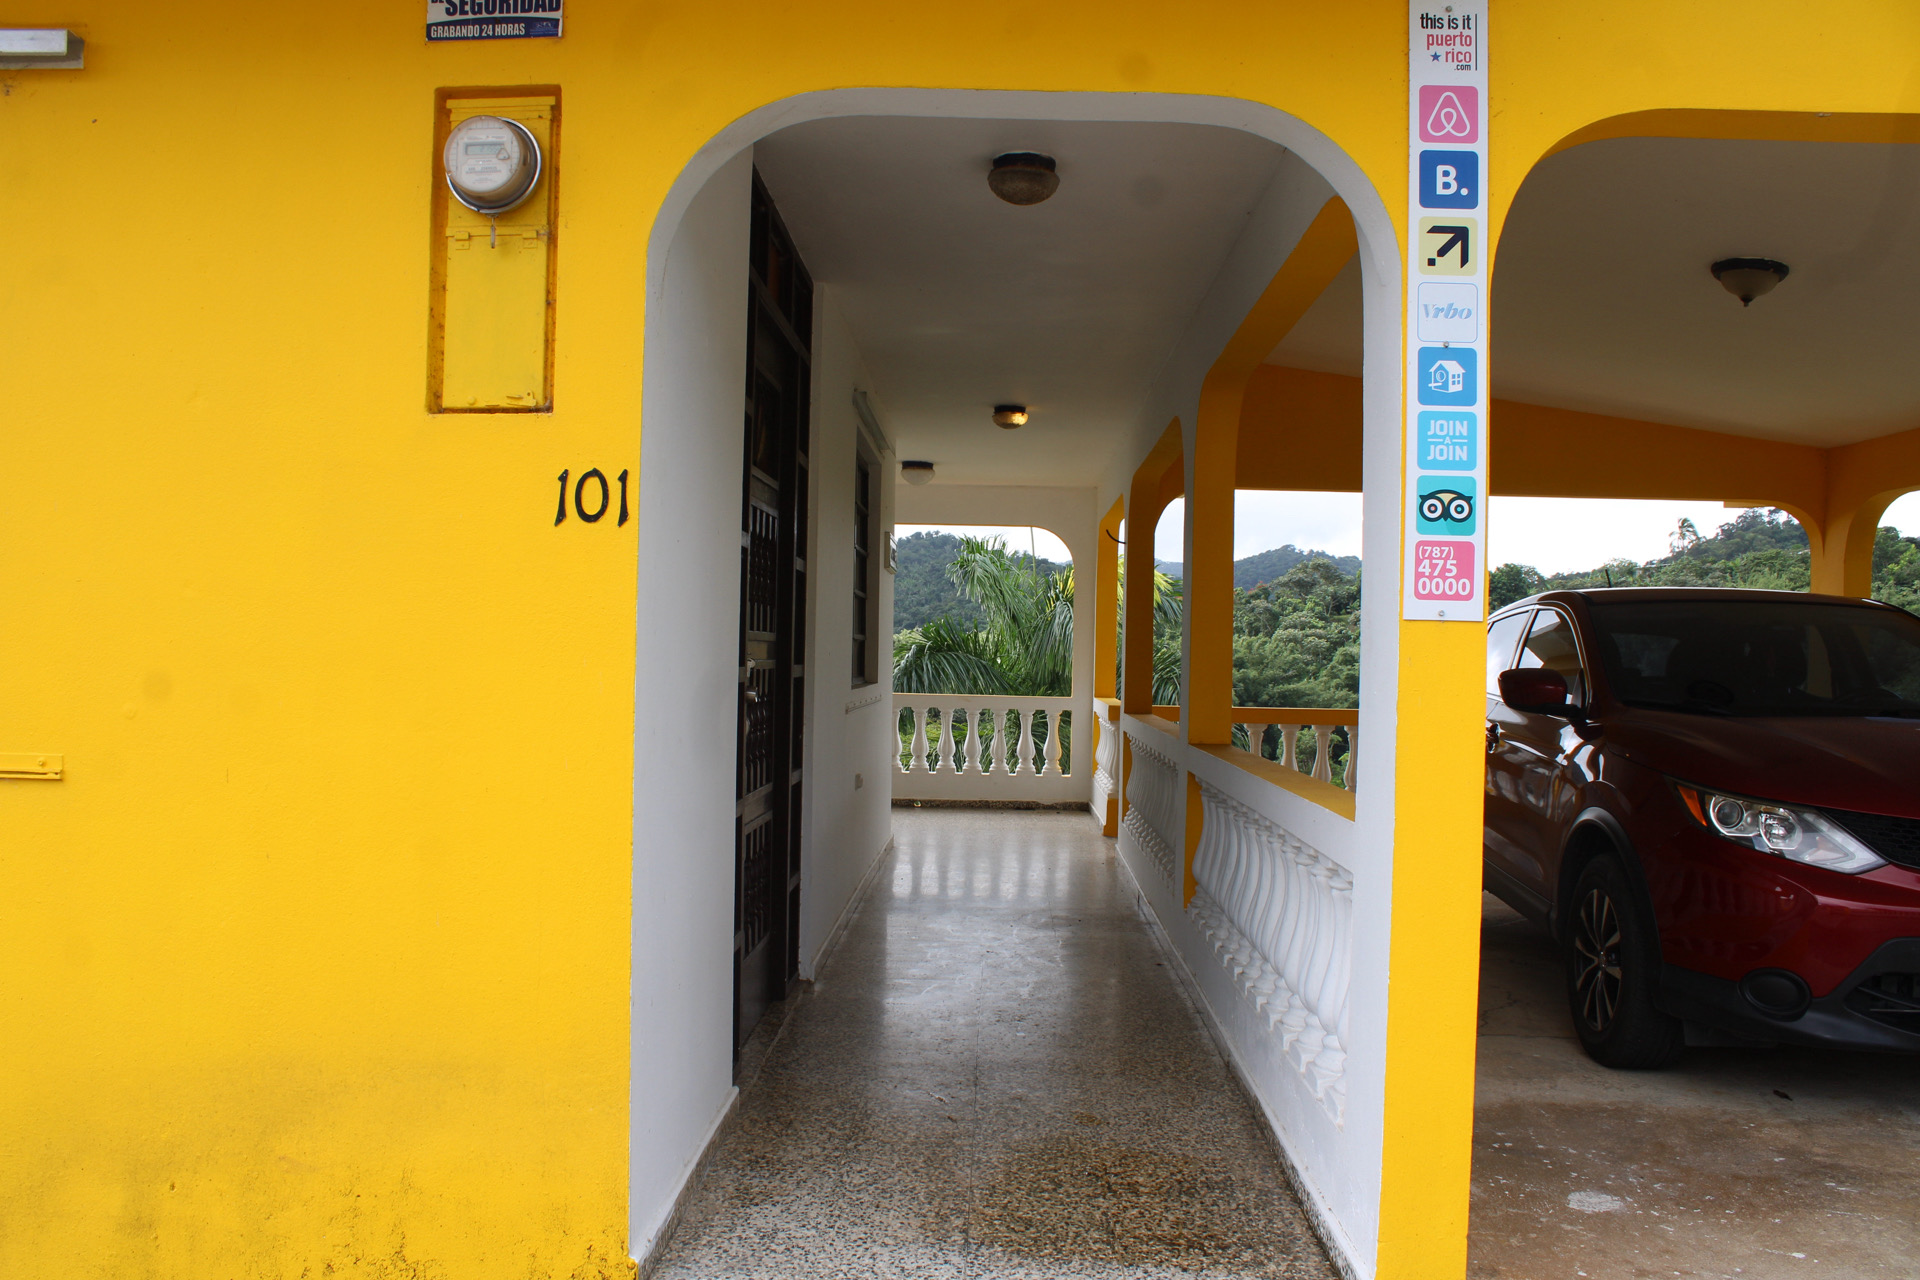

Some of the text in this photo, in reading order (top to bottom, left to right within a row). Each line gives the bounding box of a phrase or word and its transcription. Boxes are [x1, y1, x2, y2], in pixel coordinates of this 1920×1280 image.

[445, 0, 560, 17] SEGURIDAD
[1420, 12, 1472, 30] this is it
[431, 24, 480, 38] GRABANDO
[481, 24, 493, 37] 24
[494, 23, 526, 36] HORAS
[1426, 31, 1473, 51] puerto
[1445, 48, 1472, 63] rico
[1422, 302, 1473, 320] Vrbo
[1427, 419, 1468, 436] JOIN
[1443, 436, 1452, 445] A
[1427, 444, 1468, 461] JOIN
[554, 467, 630, 528] 101
[1418, 546, 1454, 560] (787)
[1418, 559, 1458, 577] 475
[1417, 577, 1471, 596] 0000
